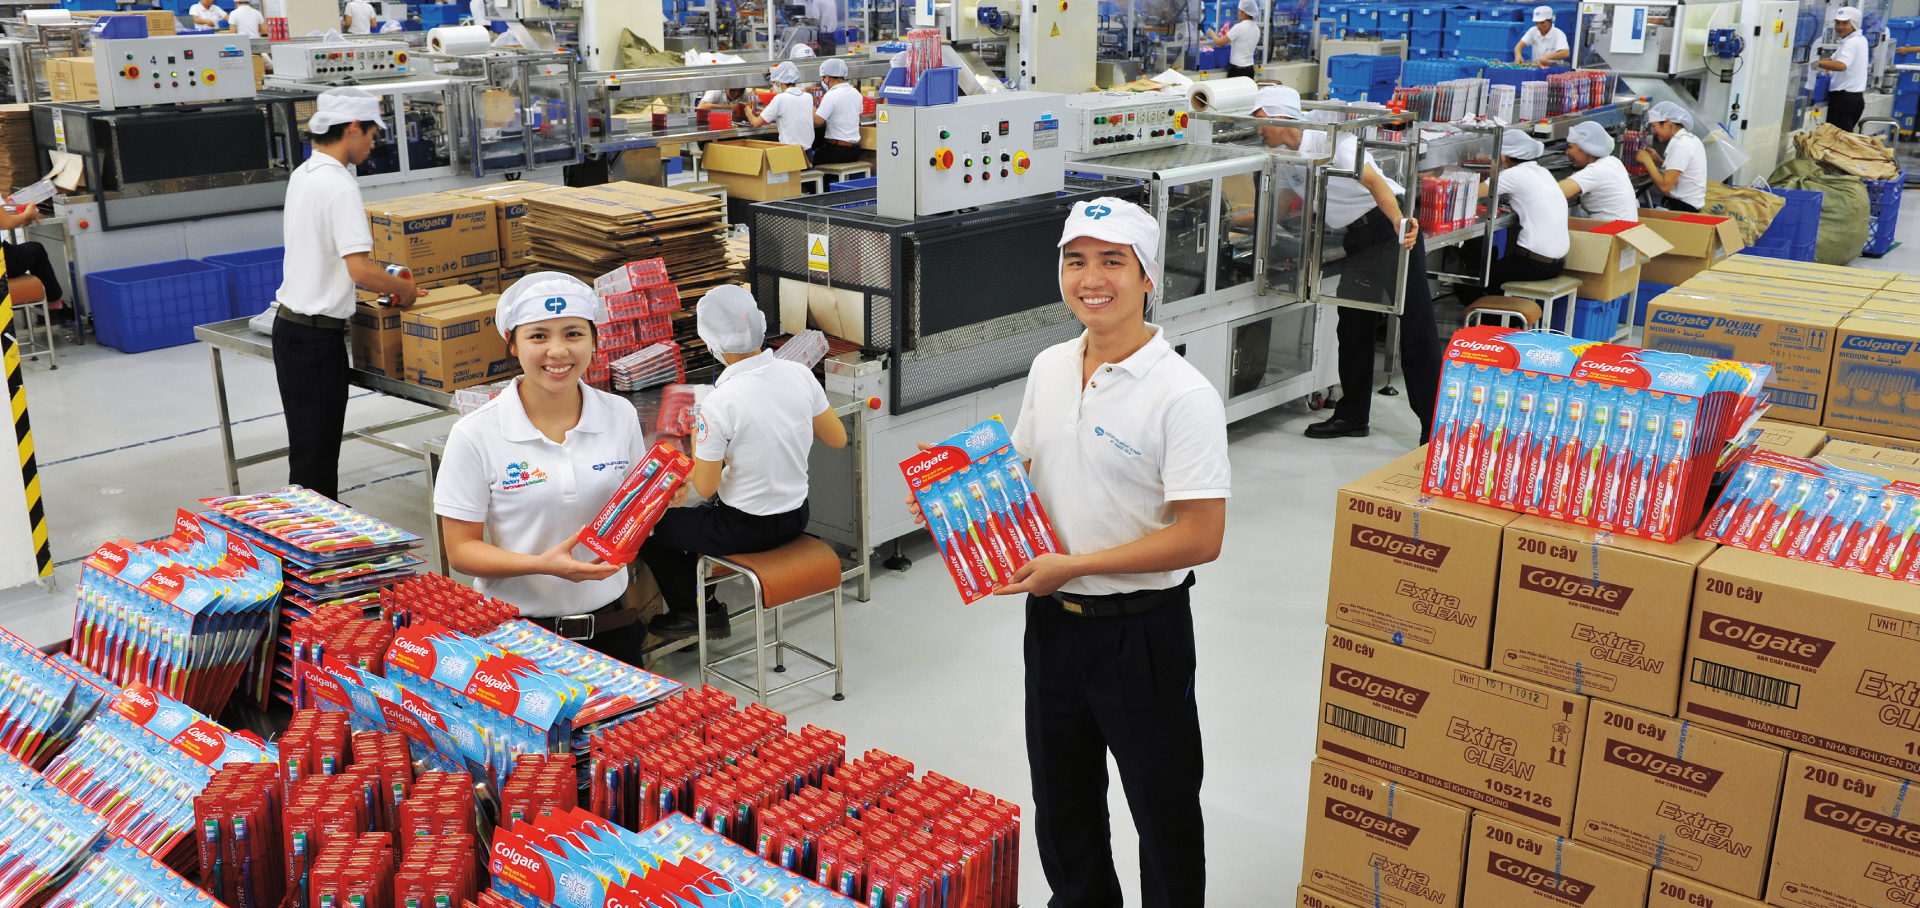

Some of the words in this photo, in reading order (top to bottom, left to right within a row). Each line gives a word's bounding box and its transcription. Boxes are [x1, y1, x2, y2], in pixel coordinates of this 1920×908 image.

[150, 56, 157, 65] 4
[359, 62, 365, 70] 3
[1136, 127, 1142, 139] 4
[891, 141, 899, 156] 5
[408, 217, 447, 231] Colgate
[1649, 325, 1676, 334] MEDIUM
[1657, 311, 1709, 328] Colgate
[1715, 317, 1764, 332] DOUBLE
[1723, 328, 1759, 338] ACTION
[1452, 338, 1505, 353] Colgate
[1525, 349, 1557, 361] Extra
[1839, 351, 1869, 360] MEDIUM
[1848, 337, 1906, 352] Colgate
[1580, 360, 1635, 375] Colgate
[1657, 371, 1692, 383] Extra
[965, 430, 991, 448] Extra
[906, 451, 949, 476] Colgate
[1430, 440, 1442, 476] Colgate
[1453, 444, 1466, 480] Colgate
[1478, 448, 1490, 485] Colgate
[1501, 453, 1514, 490] Colgate
[1525, 457, 1538, 494] Colgate
[1550, 462, 1564, 499] Colgate
[1575, 465, 1588, 505] Colgate
[593, 502, 616, 531] Colgate
[1349, 497, 1374, 515] 200
[1377, 506, 1402, 523] cây
[177, 516, 200, 532] Colgate
[612, 516, 635, 545] Colgate
[96, 547, 123, 563] Colgate
[227, 542, 251, 559] Colgate
[586, 537, 612, 557] Colgate
[989, 537, 1007, 568] Colgate
[1008, 528, 1026, 559] Colgate
[1357, 529, 1437, 561] Colgate
[1517, 536, 1547, 555] 200
[1550, 545, 1578, 563] cây
[950, 555, 968, 587] Colgate
[970, 546, 988, 577] Colgate
[151, 572, 179, 588] Colgate
[1527, 570, 1619, 603] Colgate
[1706, 578, 1734, 596] 200
[1736, 585, 1763, 604] cây
[1395, 579, 1461, 610] Extra
[1412, 601, 1477, 628] CLEAN
[1876, 618, 1897, 632] VN11
[394, 636, 430, 658] Colgate
[1332, 635, 1353, 651] 200
[1355, 643, 1375, 659] cây
[1571, 623, 1646, 654] Extra
[1709, 618, 1817, 658] Colgate
[440, 655, 464, 671] Extra
[1590, 645, 1664, 674] CLEAN
[1757, 654, 1769, 662] BÀN
[305, 670, 338, 691] Colgate
[475, 670, 512, 693] Colgate
[1336, 669, 1418, 706] Colgate
[123, 688, 152, 708] Colgate
[523, 691, 547, 707] Extra
[383, 705, 418, 728] Colgate
[1603, 711, 1634, 731] 200
[1637, 722, 1667, 741] cây
[187, 727, 218, 748] Colgate
[1446, 716, 1518, 756] Extra
[1747, 719, 1773, 733] NHÃN
[1776, 727, 1800, 740] HIỆU
[1826, 740, 1847, 753] NHA
[1848, 744, 1859, 756] SĨ
[1860, 749, 1904, 768] KHUYÊN
[1463, 747, 1535, 781] CLEAN
[1612, 745, 1707, 784] Colgate
[1323, 772, 1348, 791] 200
[1350, 784, 1374, 801] cây
[1367, 756, 1388, 769] NHÃN
[1388, 763, 1407, 776] HIỆU
[1426, 775, 1443, 787] NHA
[1452, 784, 1485, 800] KHUYÊN
[1485, 793, 1510, 809] DÙNG
[1484, 778, 1553, 809] 1052126
[1804, 765, 1839, 787] 200
[1842, 779, 1877, 798] cây
[1331, 803, 1408, 839] Colgate
[1656, 800, 1734, 838] Extra
[1814, 802, 1920, 844] Colgate
[1485, 826, 1514, 846] 200
[1516, 838, 1543, 856] cây
[1675, 824, 1752, 858] CLEAN
[494, 842, 540, 873] Colgate
[1368, 852, 1430, 886] Extra
[558, 872, 589, 896] Extra
[1384, 873, 1446, 904] CLEAN
[1495, 858, 1582, 897] Colgate
[1659, 881, 1686, 901] 200
[563, 889, 595, 908] CLEAN
[1303, 894, 1323, 908] 200
